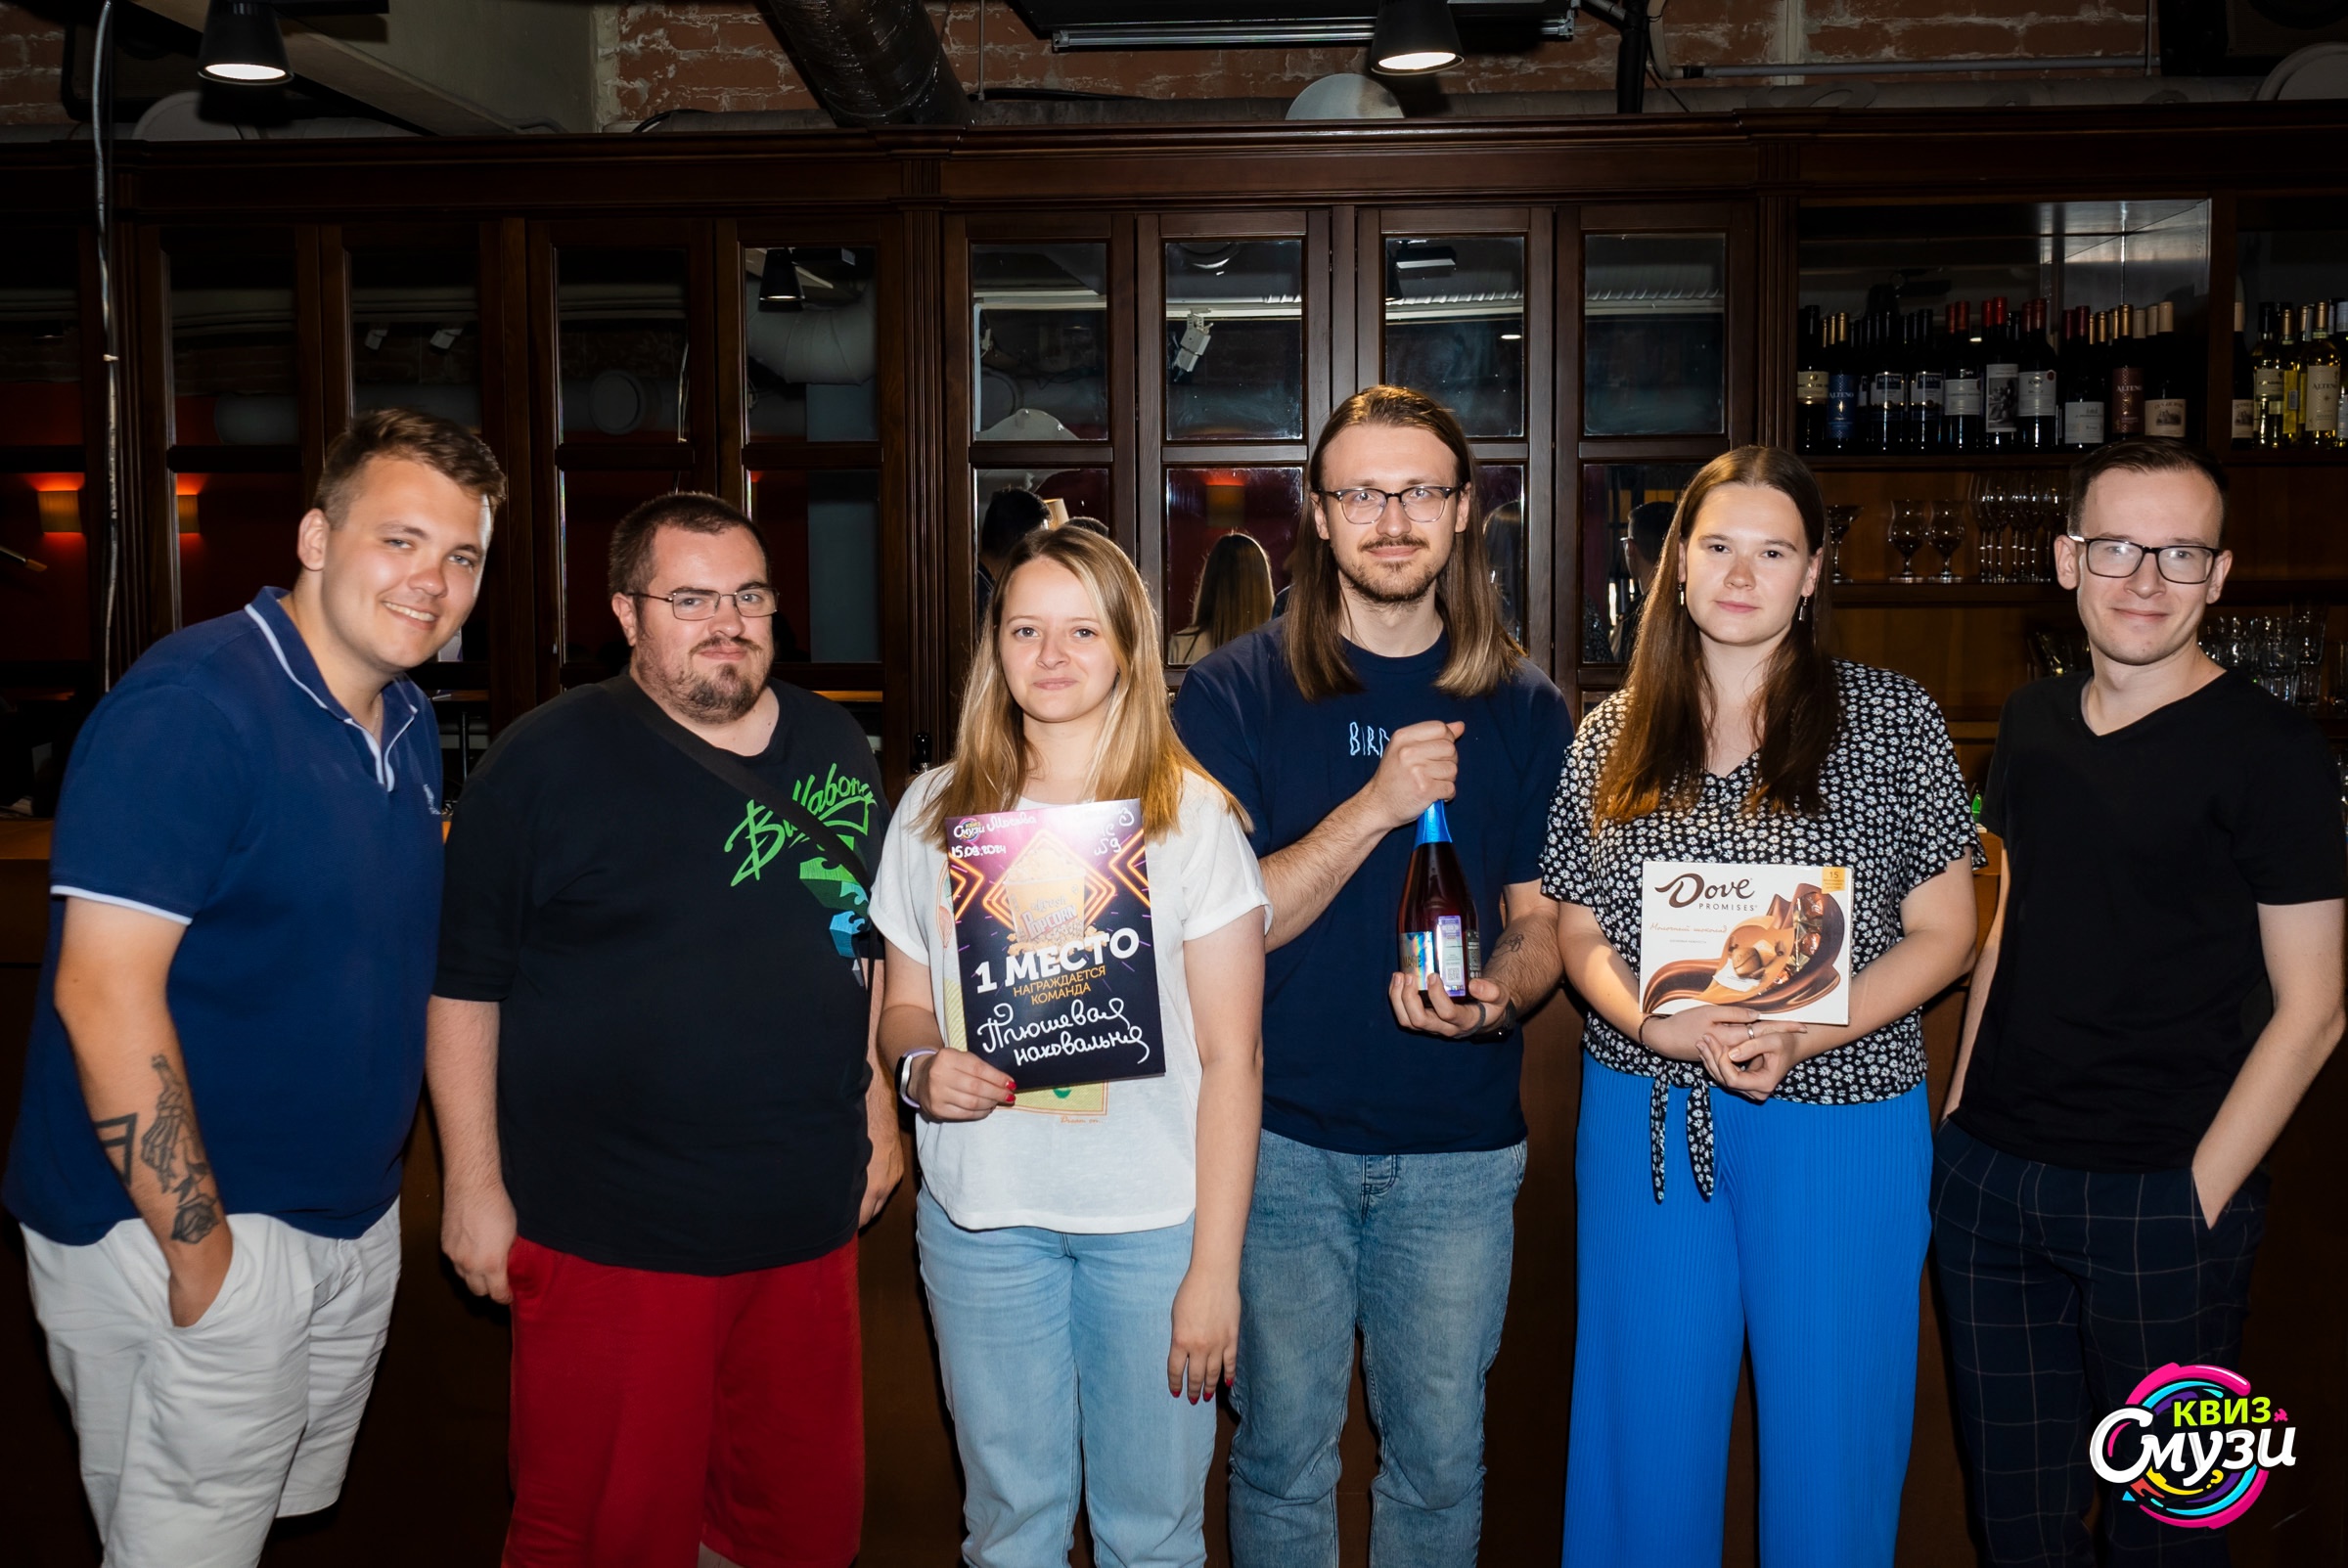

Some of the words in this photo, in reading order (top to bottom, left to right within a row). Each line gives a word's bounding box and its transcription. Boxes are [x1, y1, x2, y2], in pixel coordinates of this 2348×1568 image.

[953, 825, 985, 838] Смузи
[986, 811, 1037, 832] Москва
[1829, 871, 1839, 879] 15
[1654, 873, 1755, 909] Dove
[1698, 903, 1755, 912] PROMISES
[975, 961, 998, 994] 1
[1004, 927, 1140, 988] МЕСТО
[1013, 964, 1106, 998] НАГРАЖДАЕТСЯ
[1030, 982, 1092, 1006] КОМАНДА
[977, 998, 1131, 1053] Плюшевая
